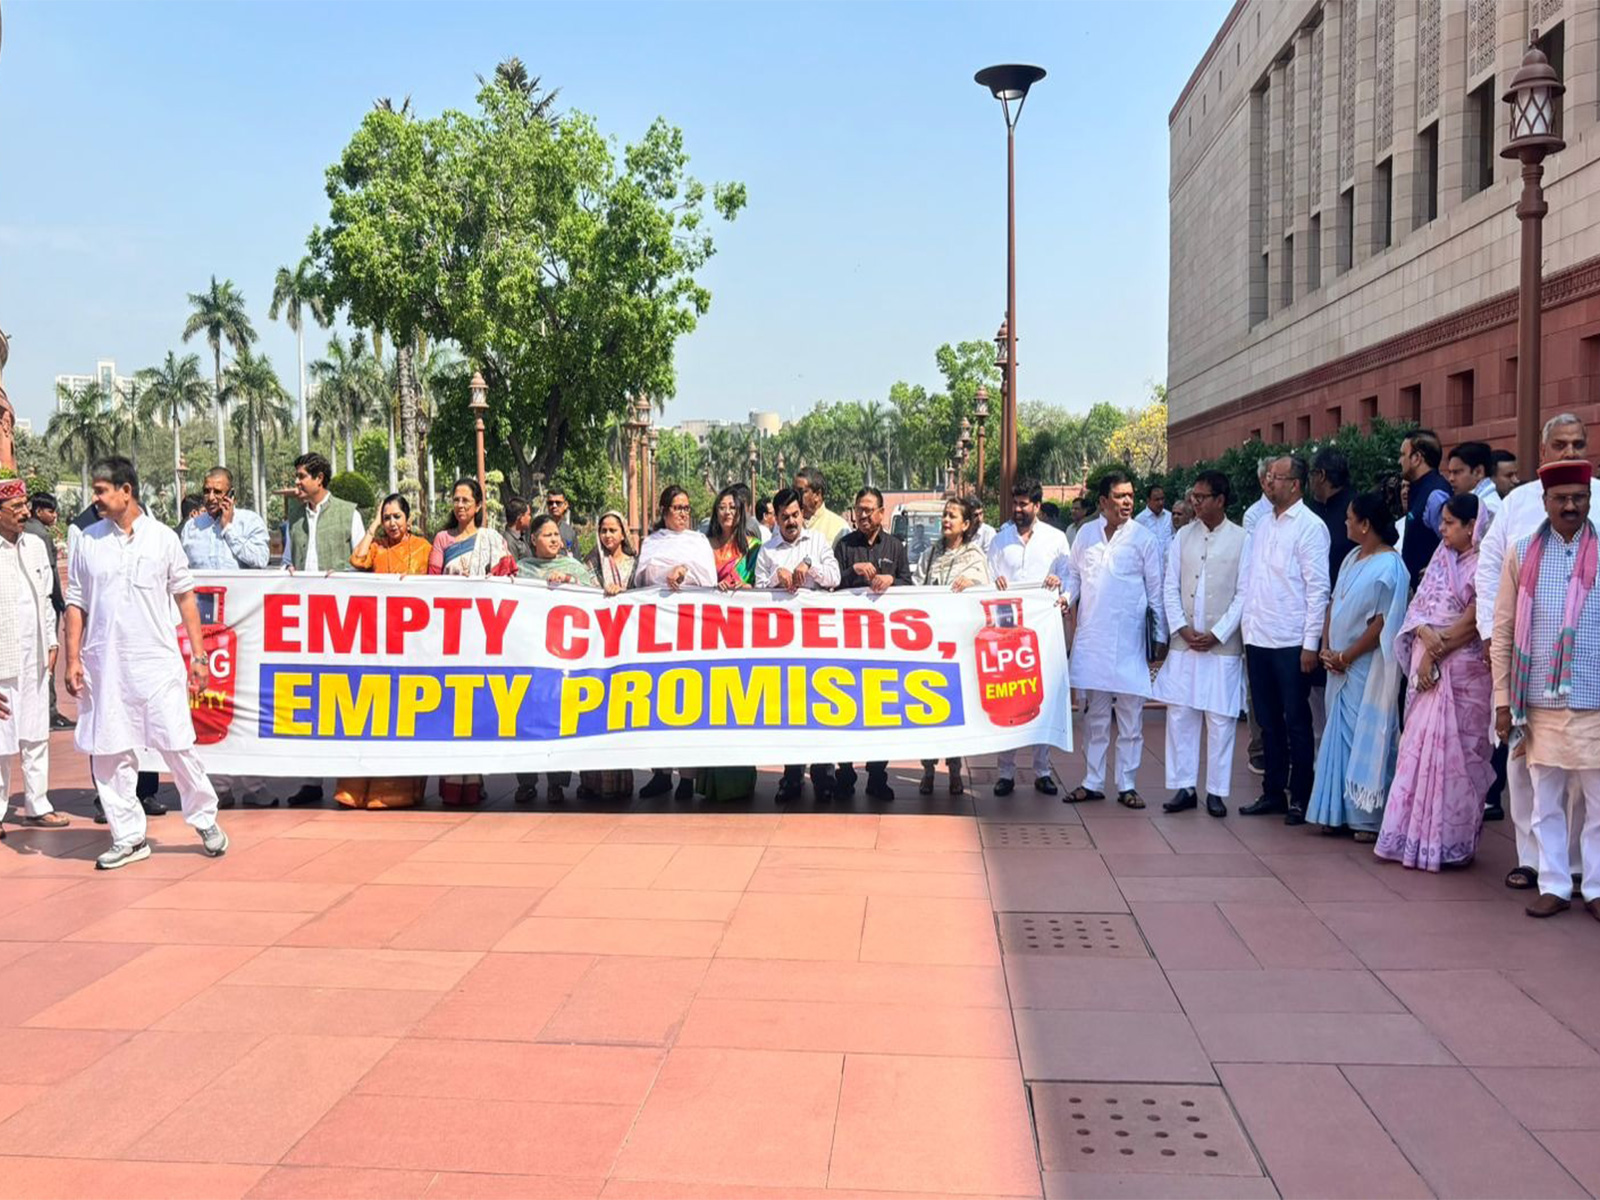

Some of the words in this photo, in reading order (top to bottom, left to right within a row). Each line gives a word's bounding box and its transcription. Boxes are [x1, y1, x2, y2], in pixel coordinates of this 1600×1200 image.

[263, 593, 518, 655] EMPTY
[545, 604, 957, 660] CYLINDERS,
[981, 646, 1036, 673] LPG
[273, 673, 532, 737] EMPTY
[560, 666, 952, 737] PROMISES
[985, 677, 1037, 699] EMPTY
